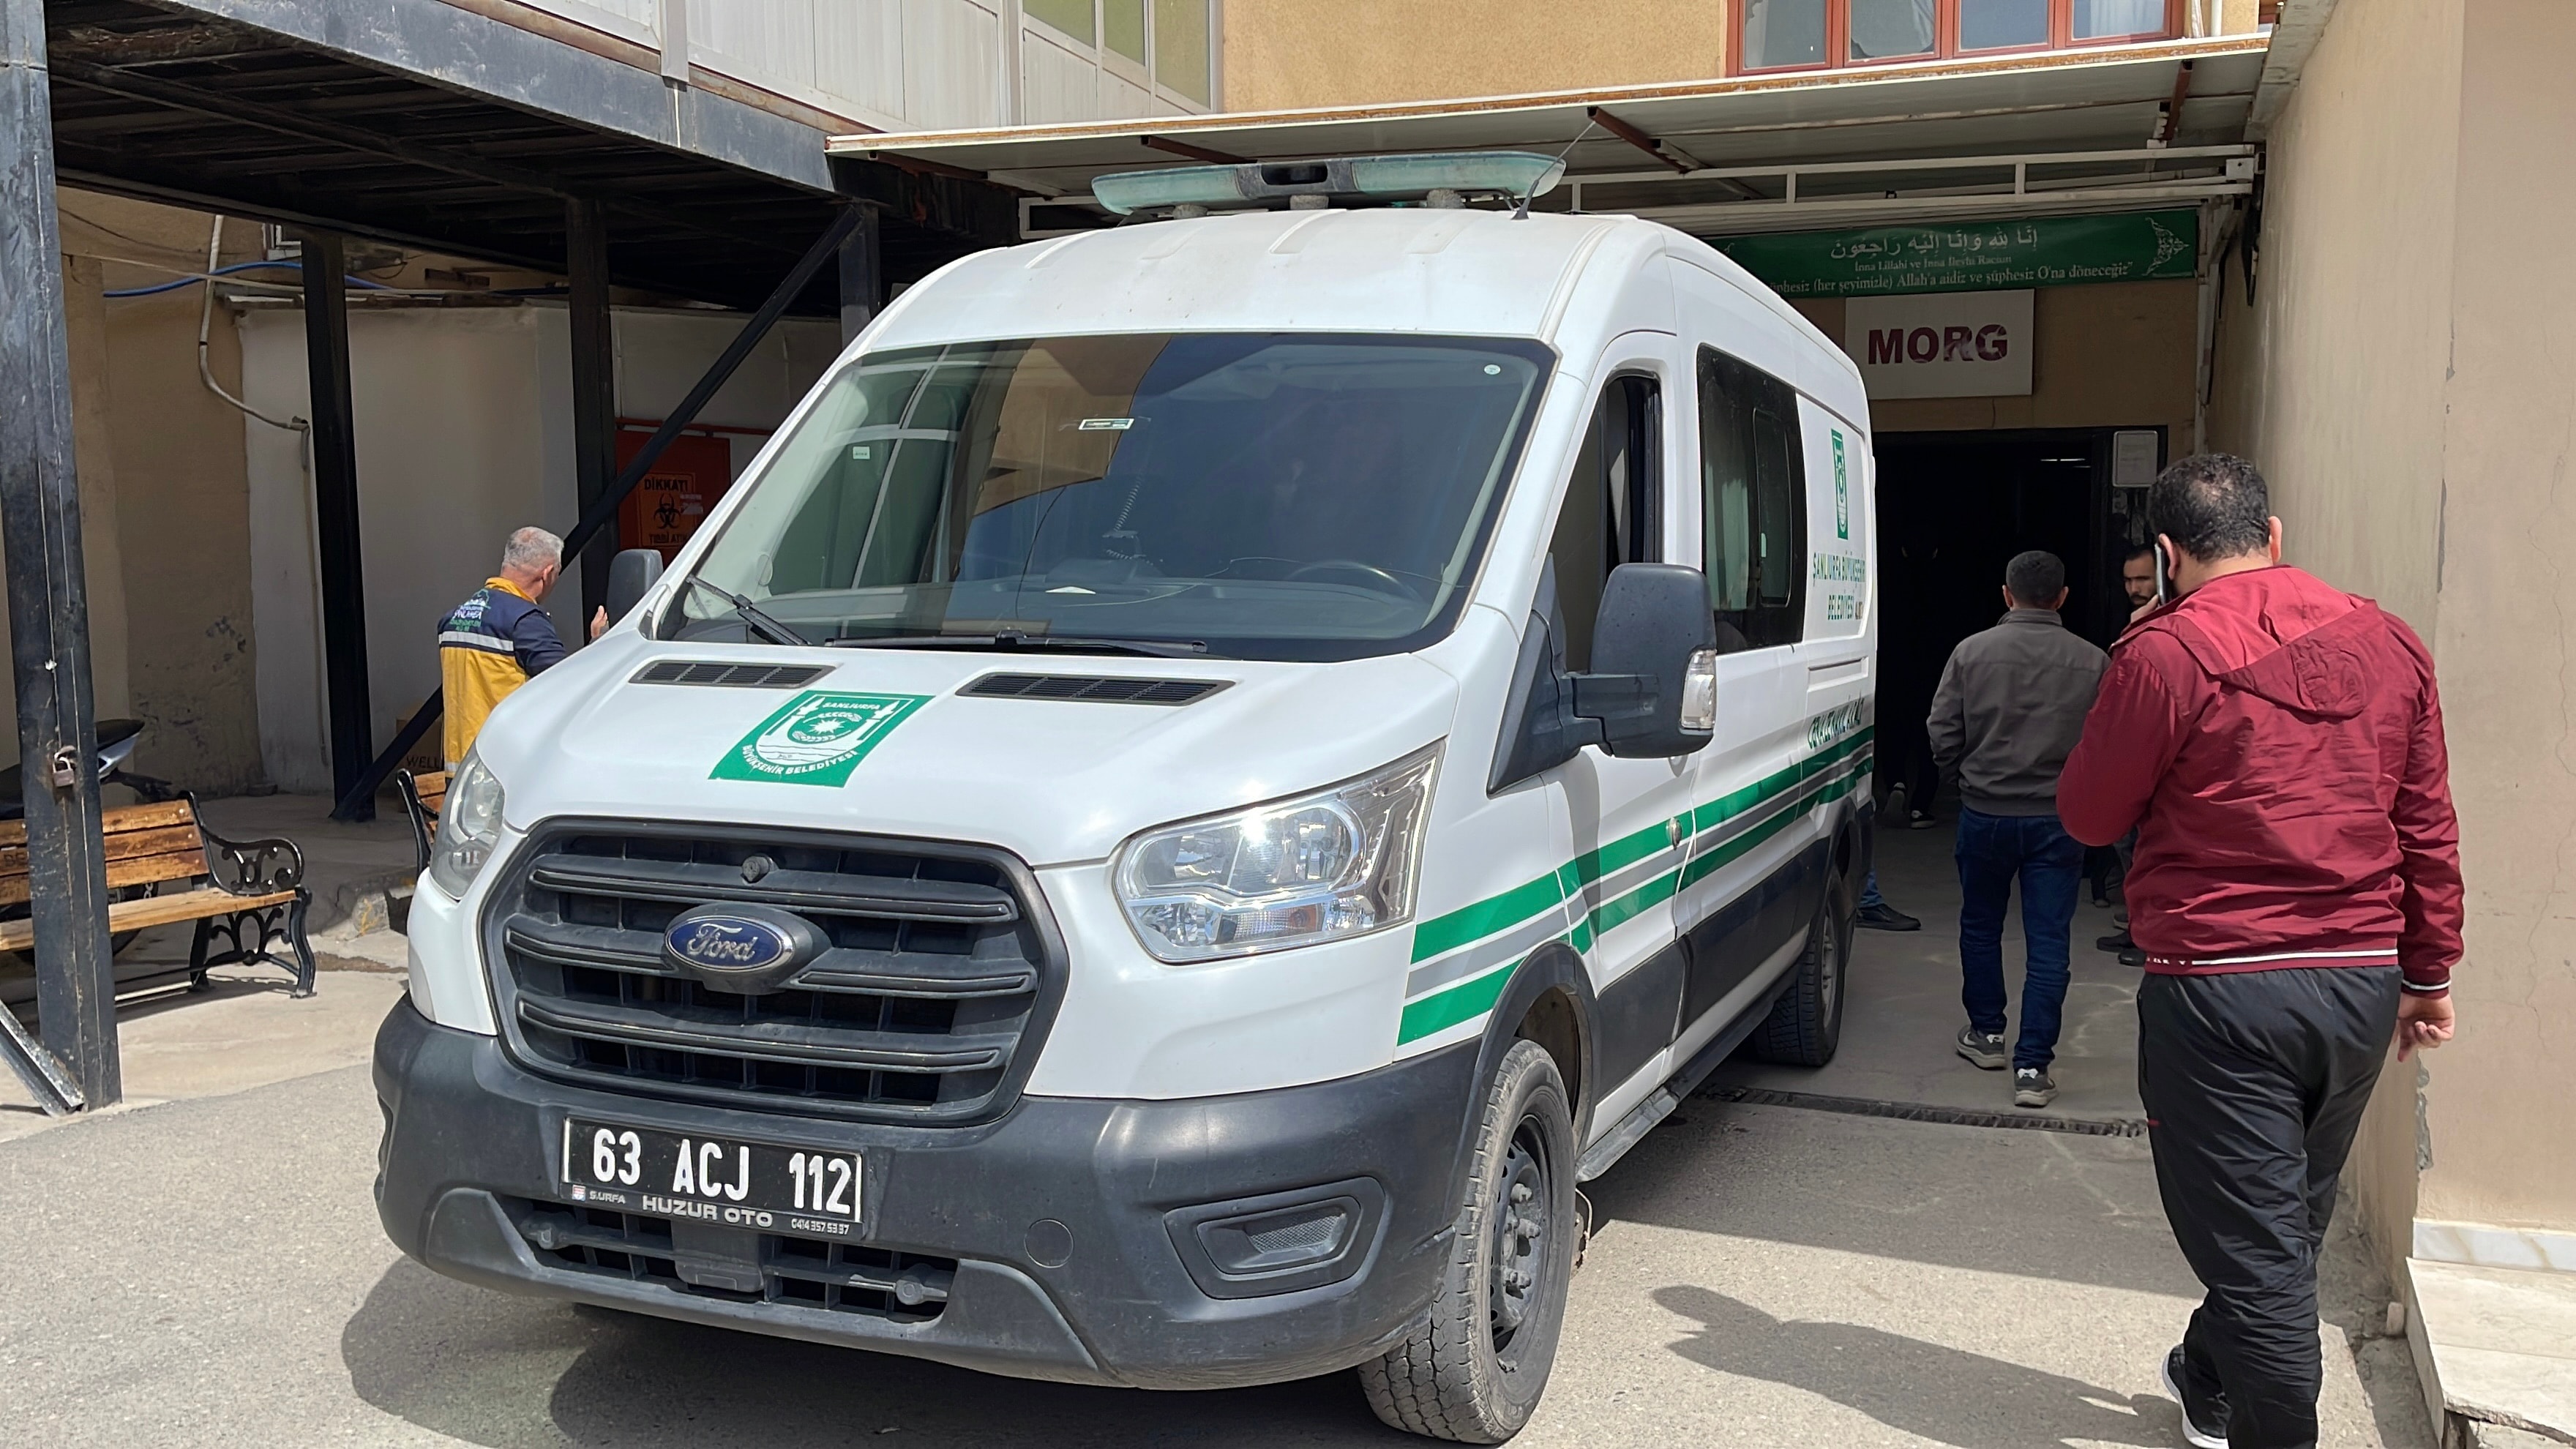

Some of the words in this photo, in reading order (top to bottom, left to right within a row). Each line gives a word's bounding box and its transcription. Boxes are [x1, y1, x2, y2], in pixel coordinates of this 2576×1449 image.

[1813, 278, 1835, 293] (her
[1838, 274, 1892, 293] şeyimizle)
[1896, 272, 1936, 288] Allah'a
[1939, 271, 1966, 285] aidiz
[1969, 273, 1982, 283] ve
[1986, 267, 2034, 286] şüphesiz
[2037, 264, 2065, 280] O'na
[1878, 258, 1908, 271] Lillahi
[1868, 323, 2008, 365] MORG
[686, 923, 759, 962] Ford
[593, 1128, 641, 1186] 63
[672, 1138, 749, 1202] ACJ
[788, 1152, 852, 1215] 112
[643, 1195, 718, 1221] HUZUR
[724, 1208, 774, 1228] OTO
